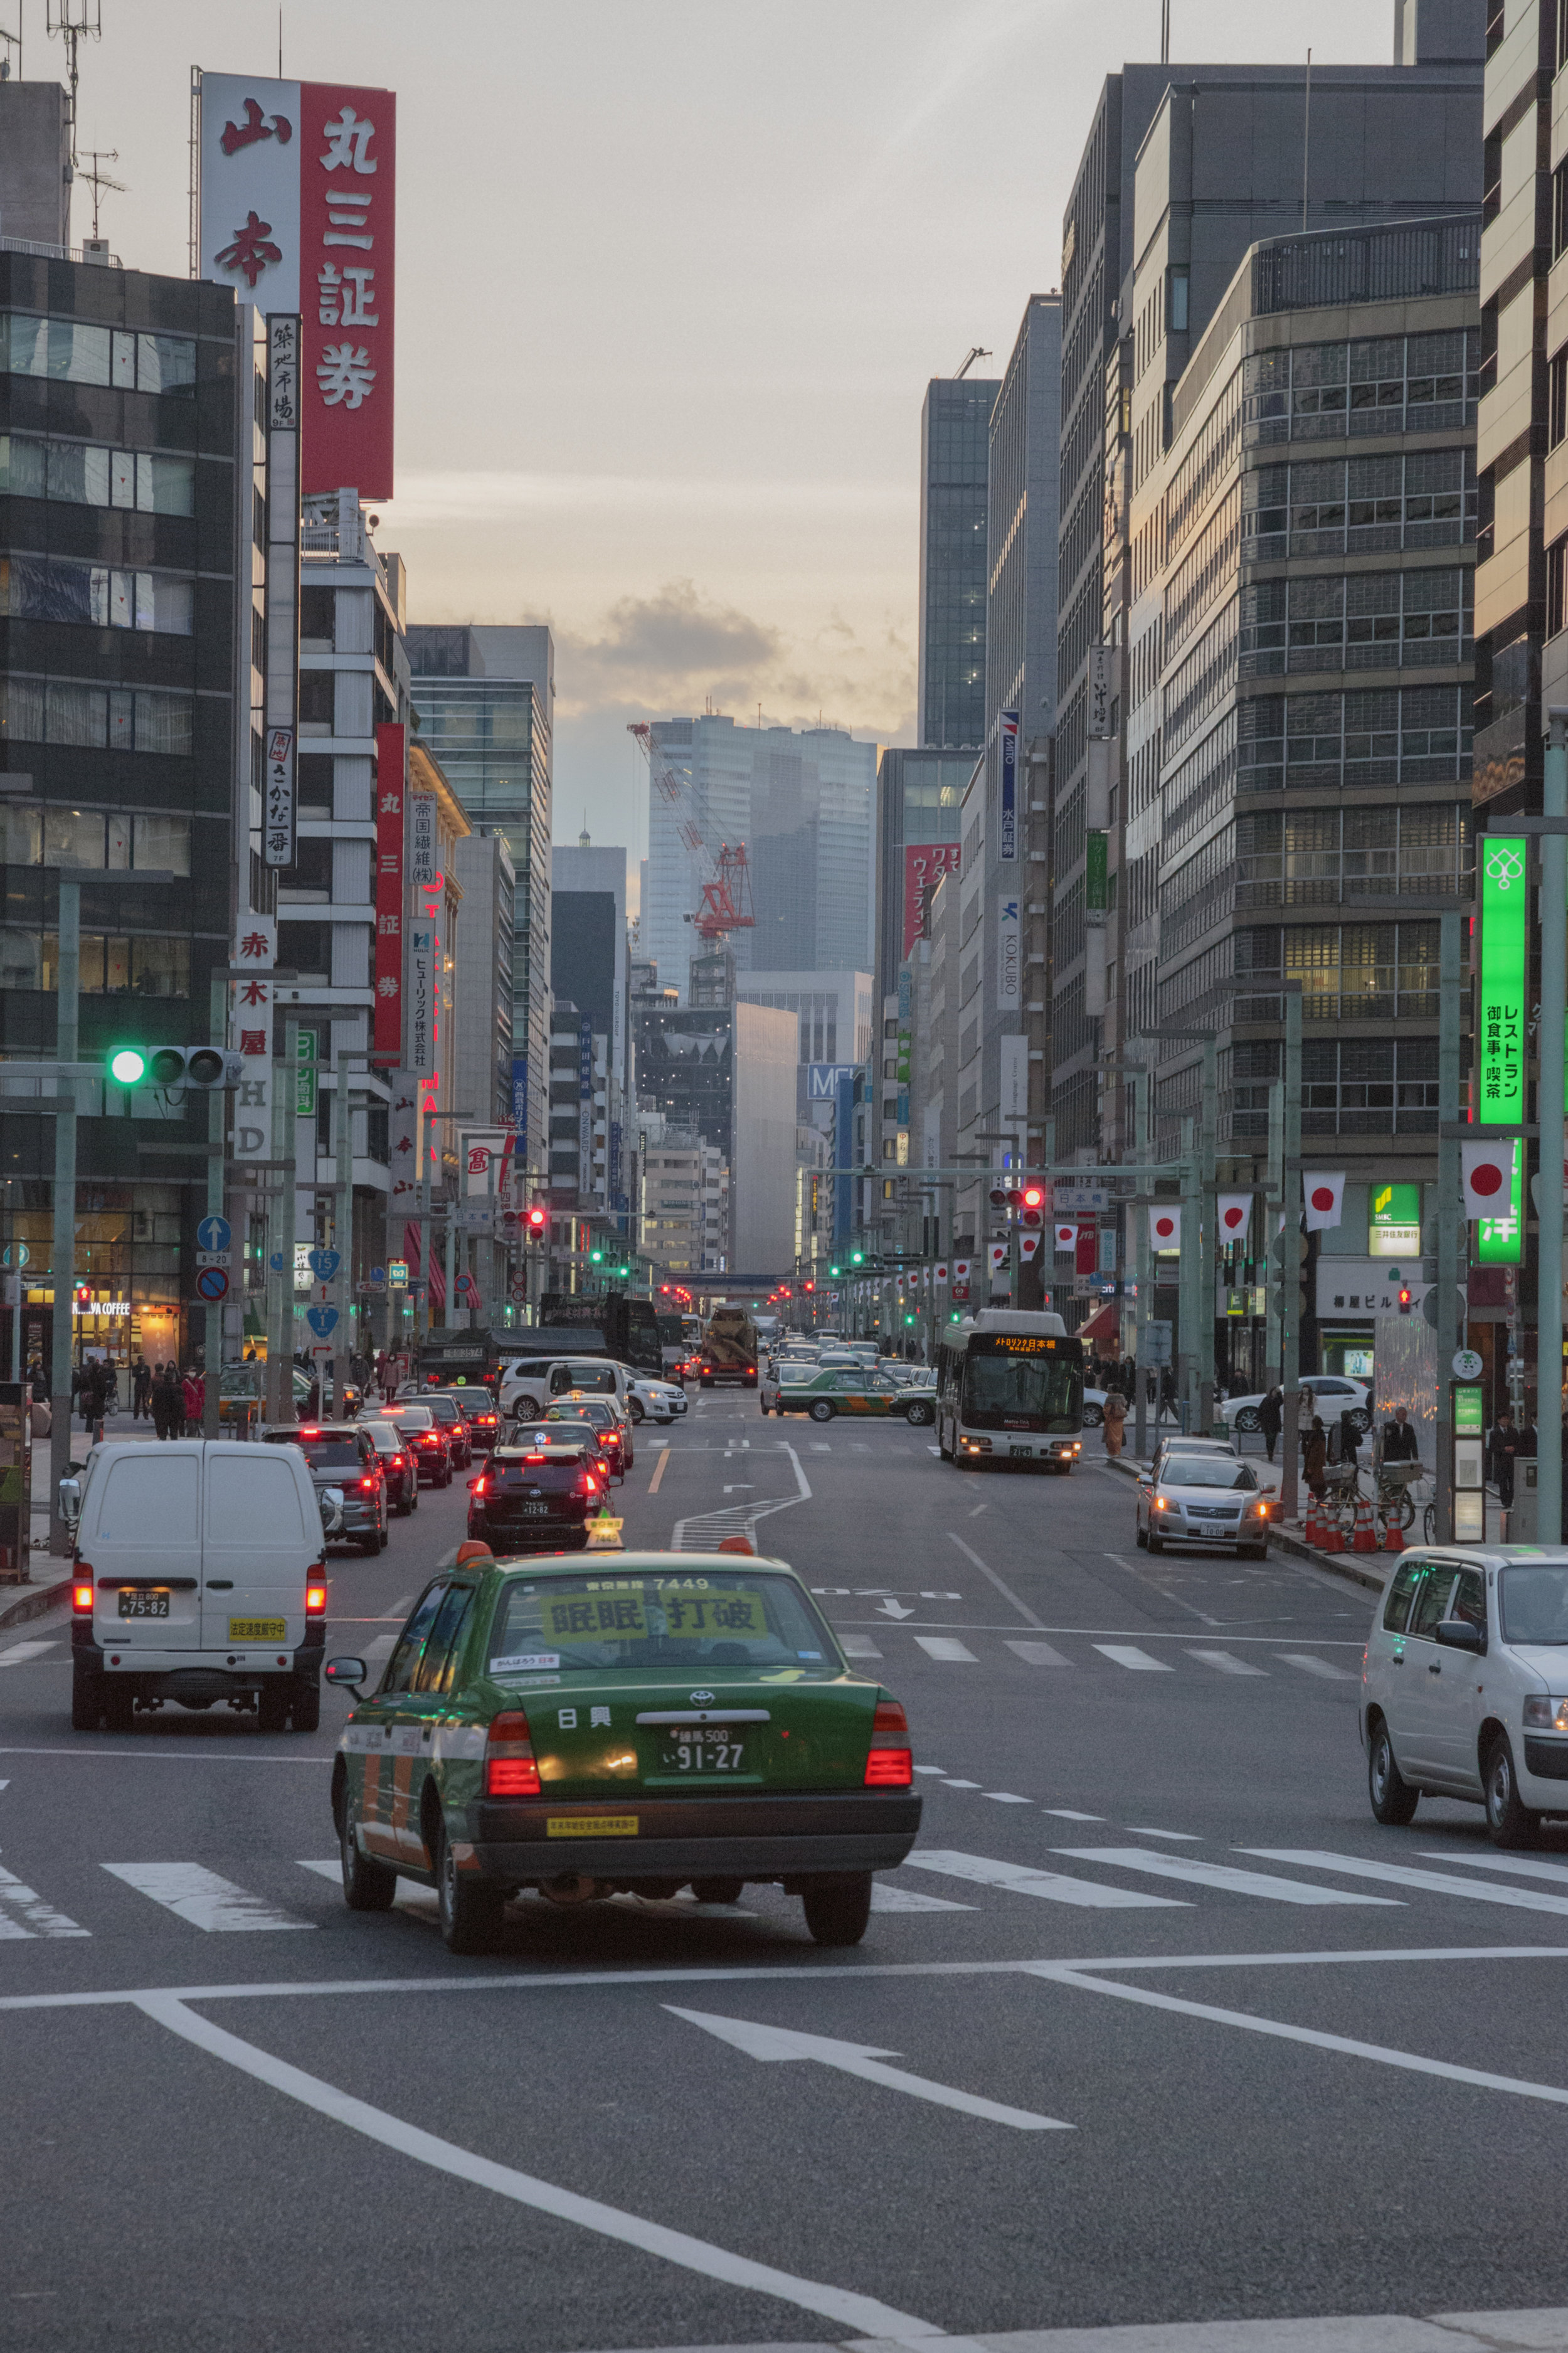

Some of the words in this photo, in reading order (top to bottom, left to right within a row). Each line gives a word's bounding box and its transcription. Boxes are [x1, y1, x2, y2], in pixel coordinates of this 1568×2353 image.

[317, 105, 378, 409] 丸三証券
[273, 325, 295, 419] 築地市場
[272, 418, 284, 427] 9F
[1005, 737, 1014, 765] MITO
[268, 764, 290, 852] さかな一番
[1003, 808, 1014, 855] 水戸証券
[413, 803, 433, 884] 帝国繊維(株)
[378, 792, 400, 998] 丸三証券
[1005, 935, 1017, 995] KOKUBO
[414, 959, 426, 1066] ヒューリック株式会社
[1486, 1005, 1501, 1100] 御食事・喫茶
[1505, 1005, 1518, 1099] レストラン
[581, 1110, 590, 1152] ONWARD
[1059, 1193, 1102, 1204] 日本橋
[1078, 1230, 1094, 1240] JTB
[1375, 1230, 1418, 1238] 三井住友銀行
[202, 1255, 226, 1264] 8-20
[317, 1257, 333, 1270] 15
[102, 1302, 130, 1315] COFFEE
[319, 1314, 326, 1327] 1
[995, 1337, 1056, 1349] メトロリンク日本橋
[595, 1534, 618, 1543] 7449
[653, 1578, 709, 1590] 7449
[130, 1593, 145, 1601] 足立
[129, 1601, 167, 1615] 75-82
[230, 1622, 285, 1636] 法定速度厳守中
[496, 1658, 535, 1668] がんばろう
[558, 1706, 612, 1729] 日興
[679, 1730, 704, 1743] 練馬
[705, 1729, 729, 1742] 500
[662, 1753, 676, 1763] い
[677, 1744, 744, 1770] 91-27
